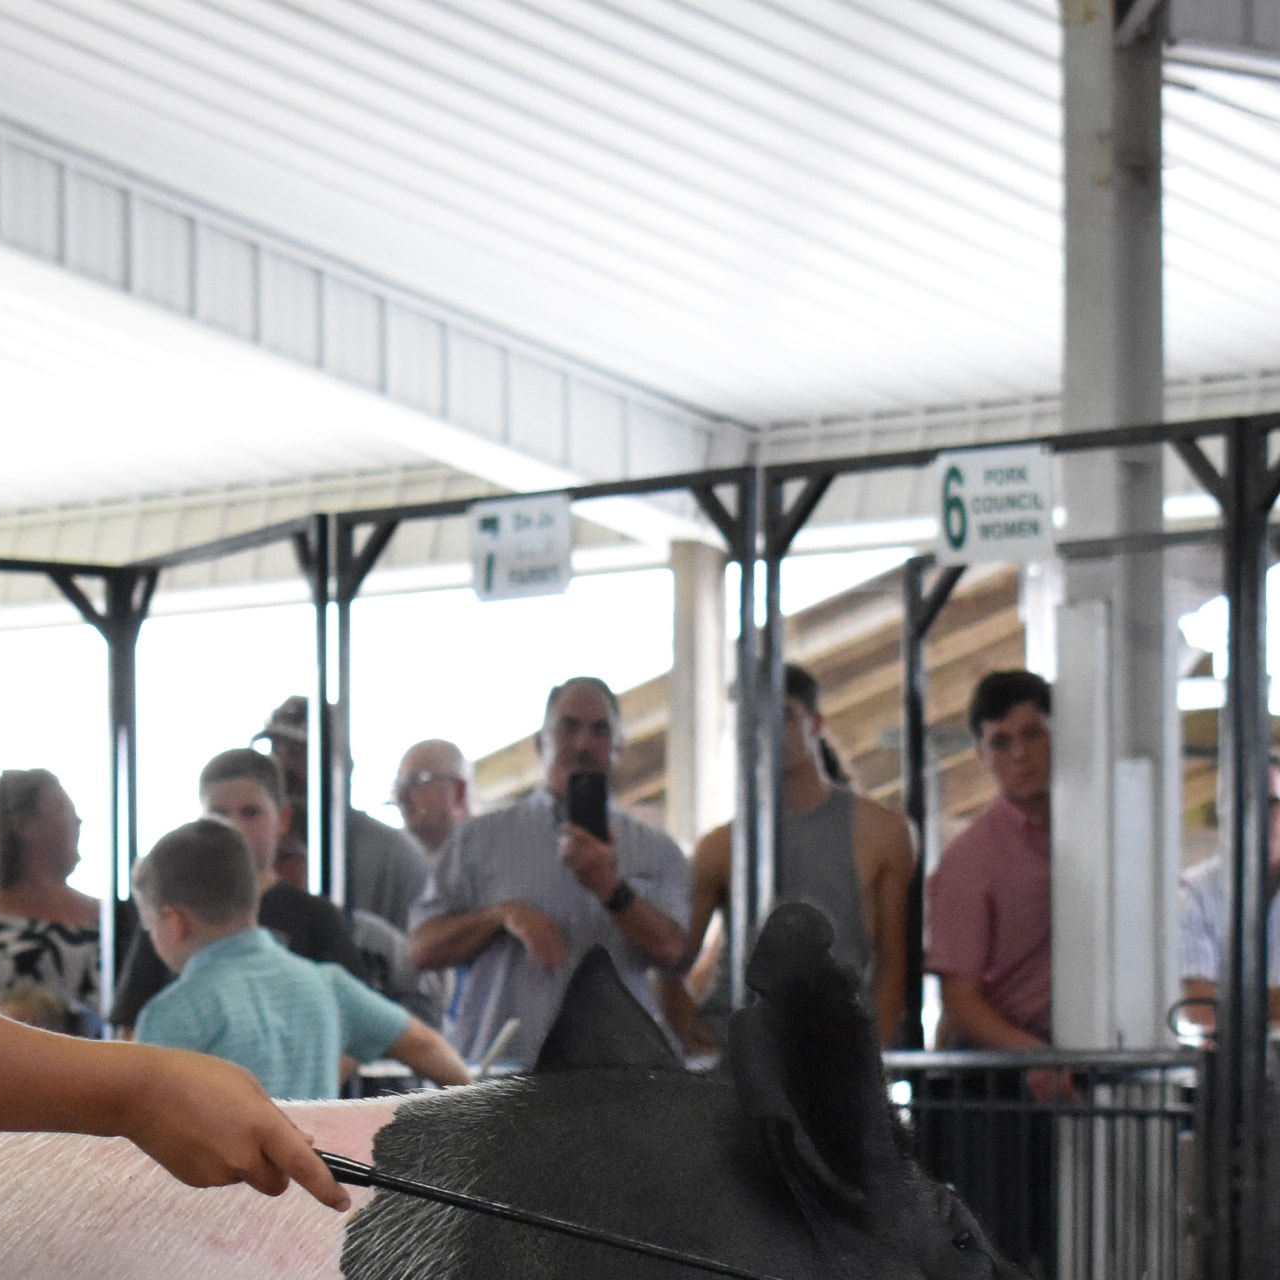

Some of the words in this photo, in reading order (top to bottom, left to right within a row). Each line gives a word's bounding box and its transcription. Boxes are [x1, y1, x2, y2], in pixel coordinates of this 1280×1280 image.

[984, 467, 1028, 486] PORK
[942, 466, 967, 552] 6
[971, 493, 1044, 514] COUNCIL
[978, 520, 1041, 540] WOMEN
[478, 515, 500, 593] 7
